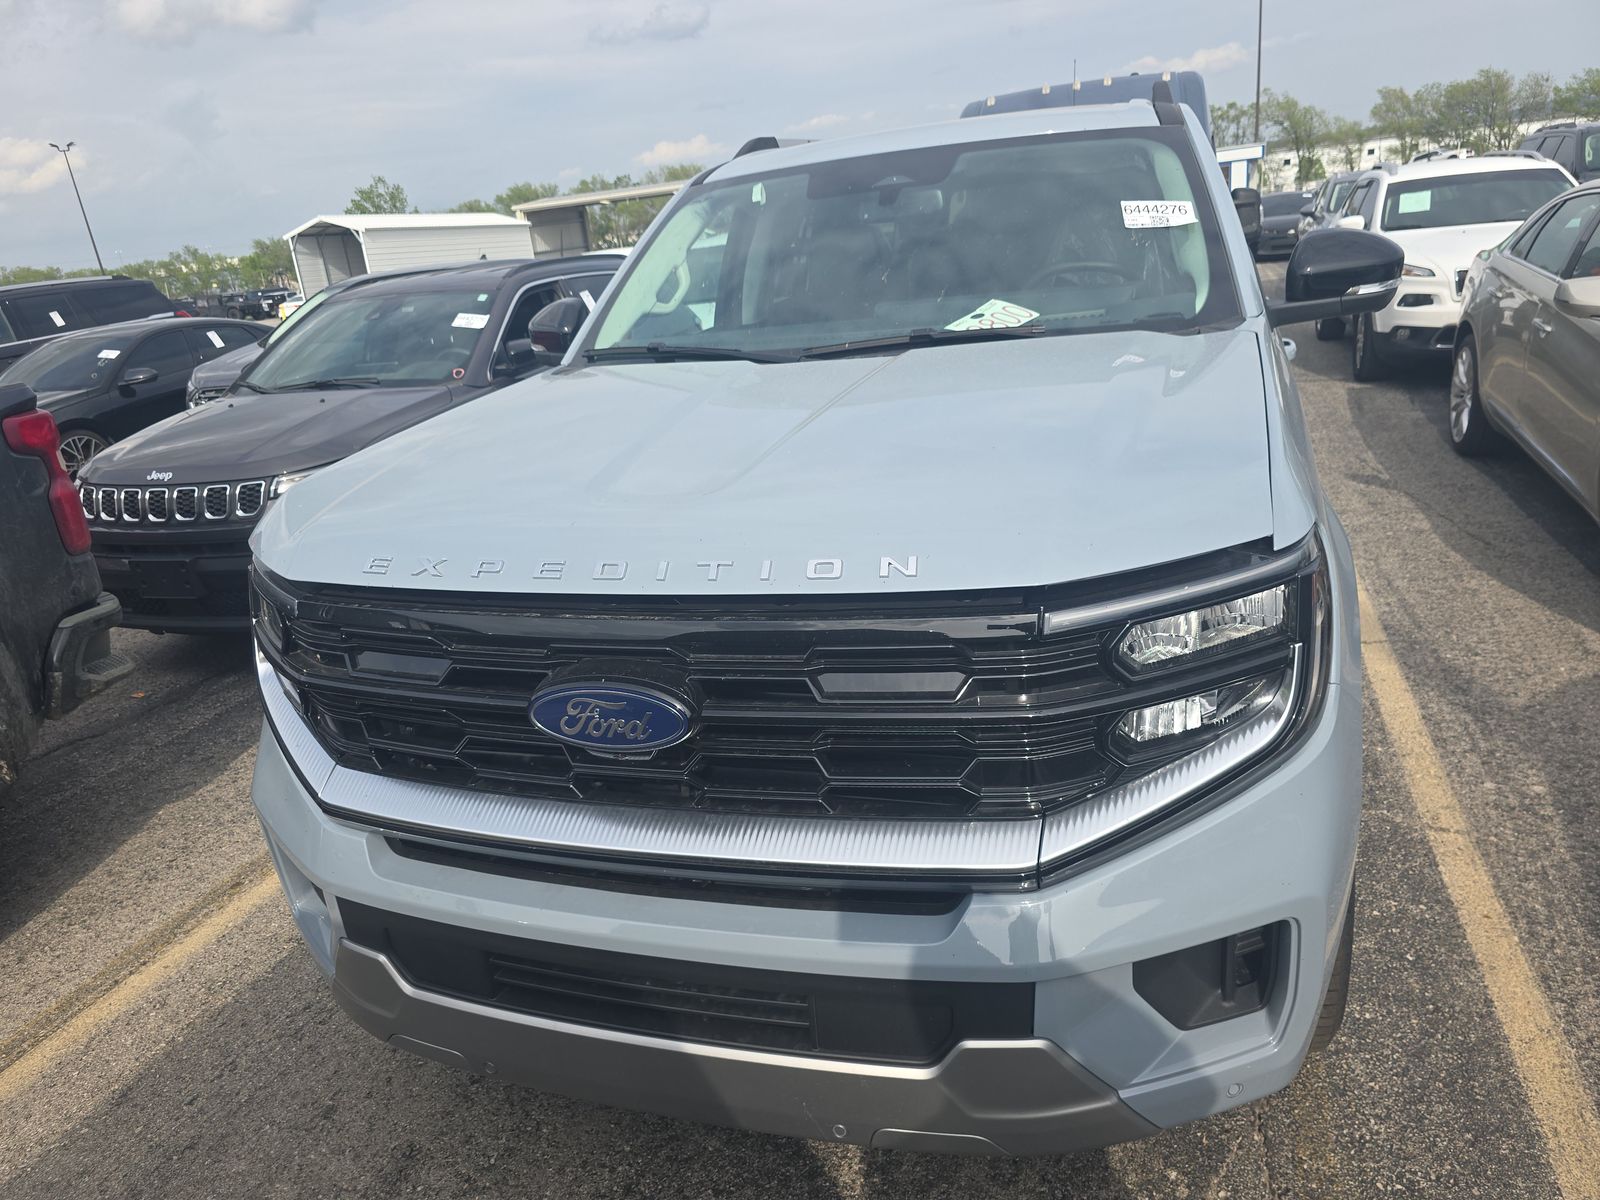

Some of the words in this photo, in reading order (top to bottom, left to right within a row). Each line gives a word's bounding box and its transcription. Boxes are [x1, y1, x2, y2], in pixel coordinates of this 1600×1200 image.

[1123, 204, 1188, 216] 6444276
[966, 305, 1034, 330] 800
[146, 470, 173, 482] Jeep
[361, 554, 919, 582] EXPEDITION
[560, 697, 653, 740] Ford
